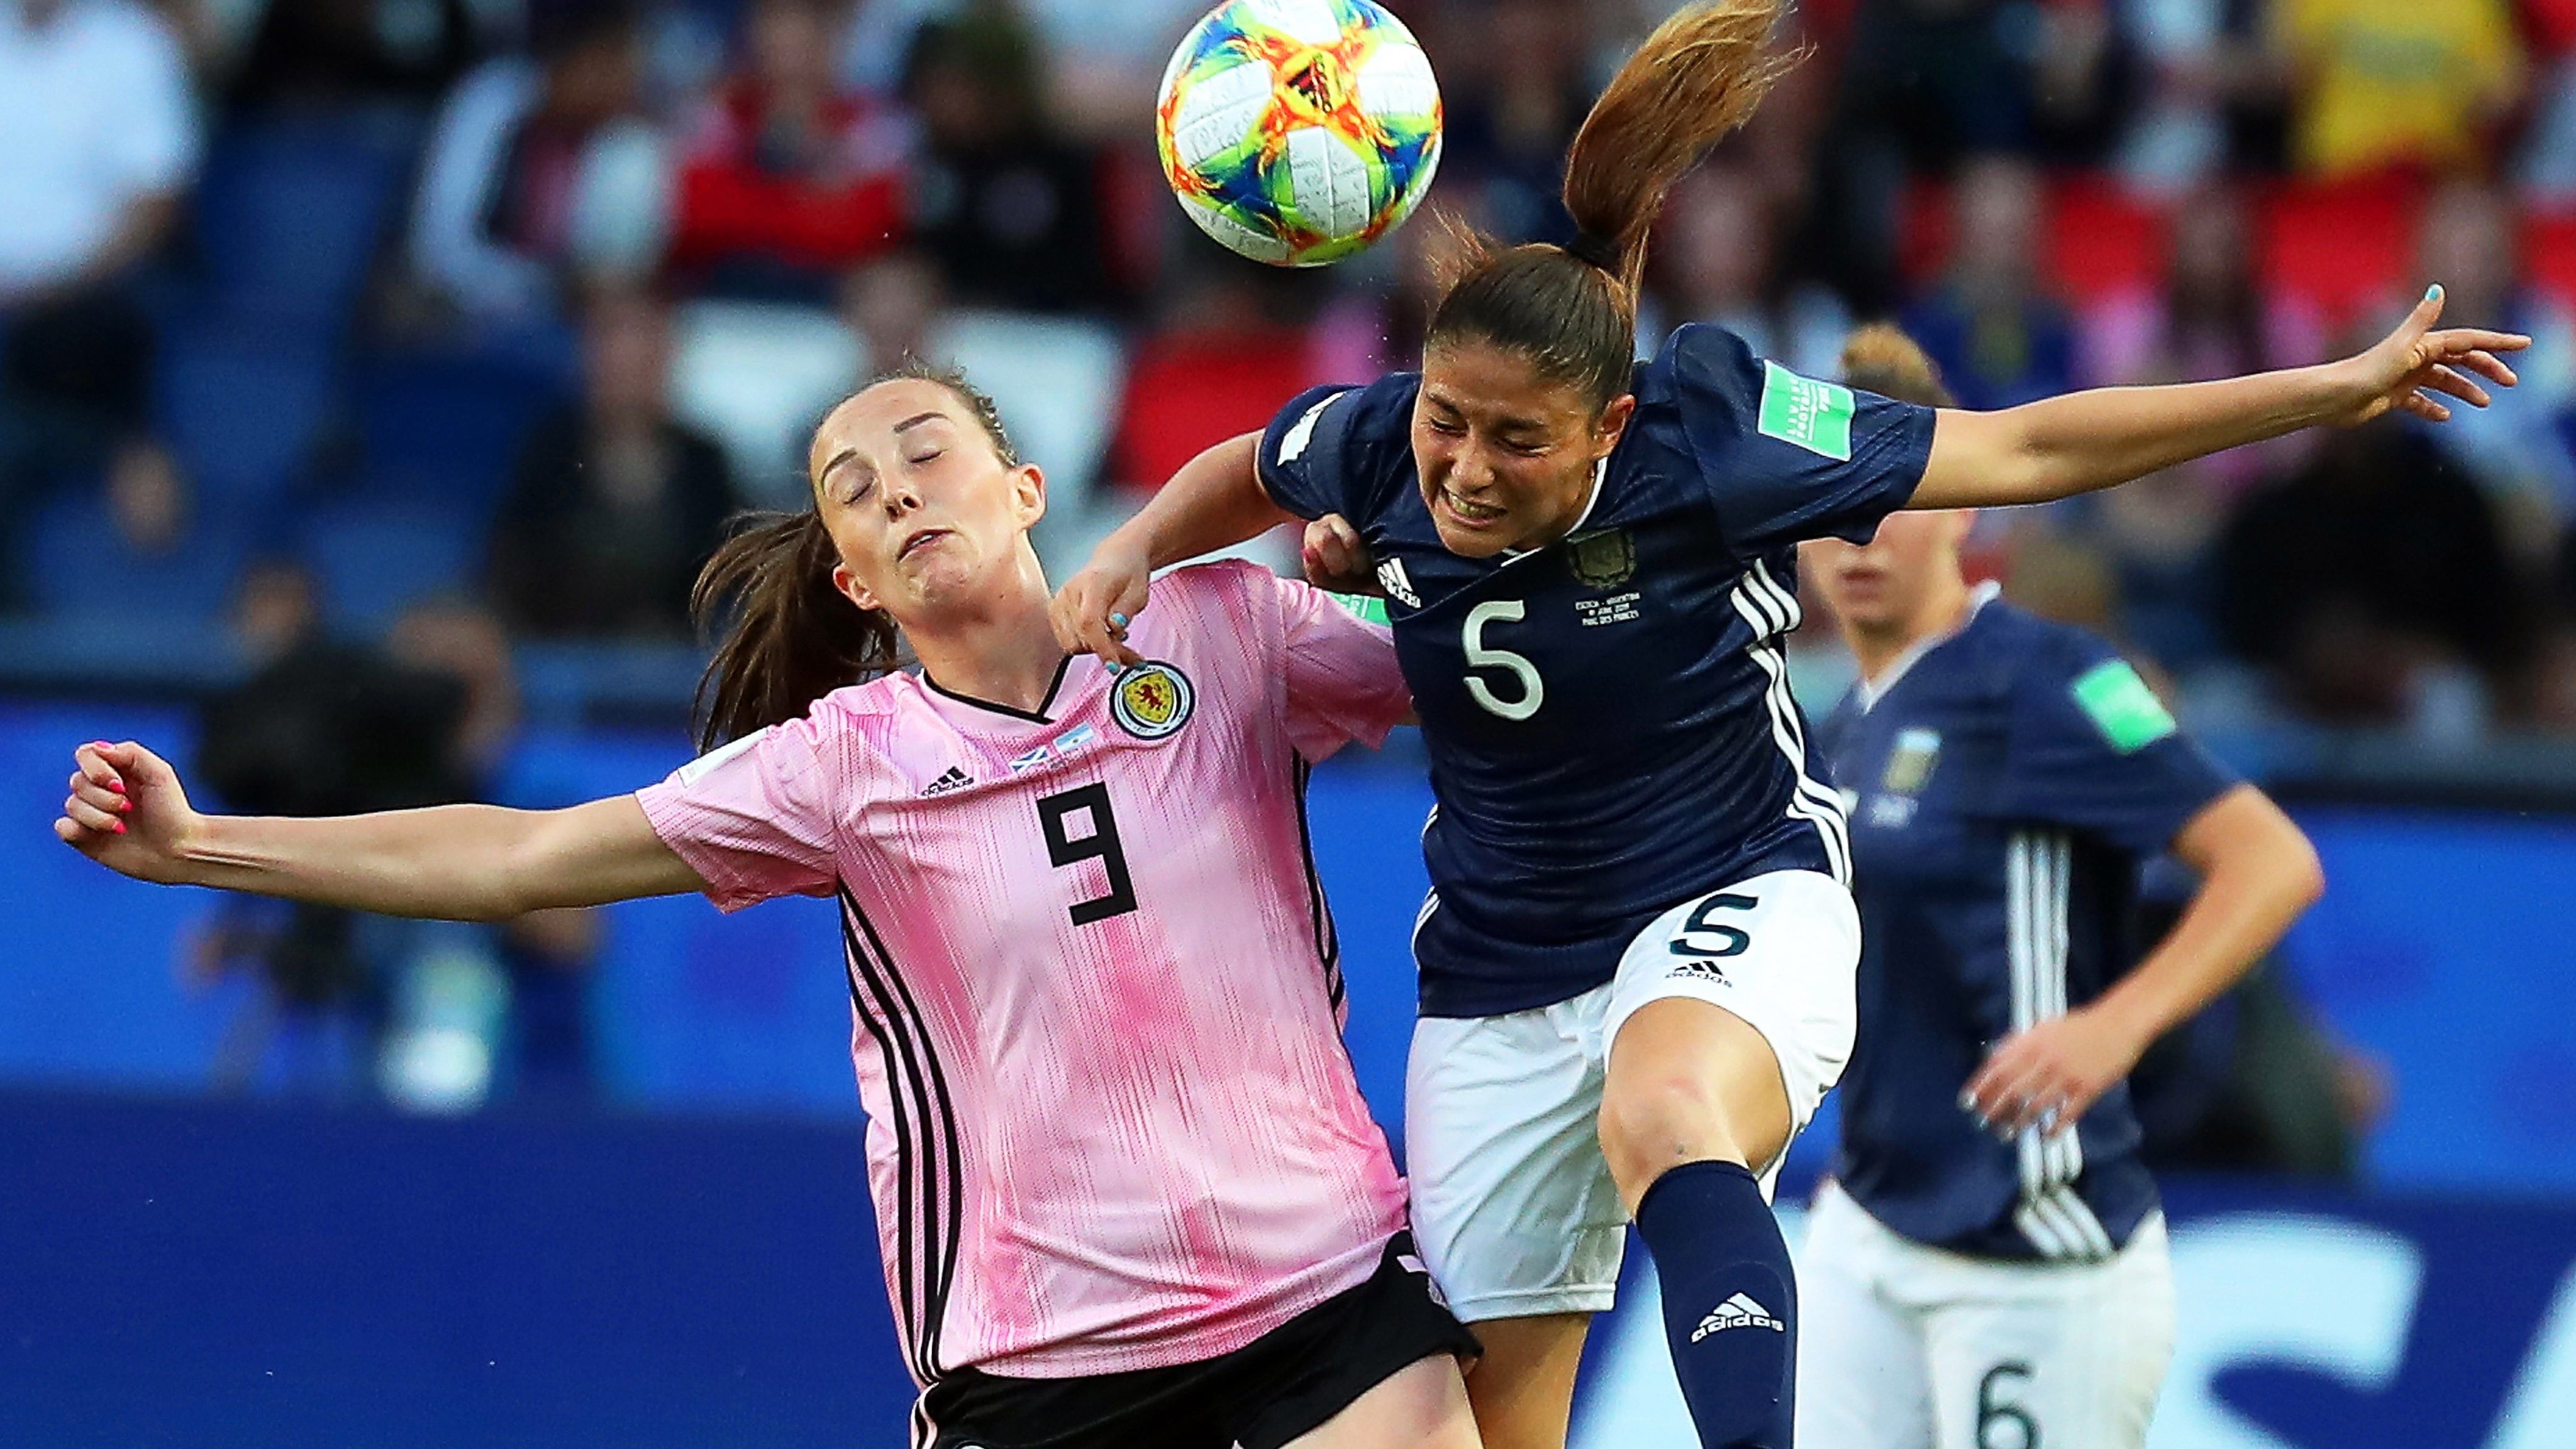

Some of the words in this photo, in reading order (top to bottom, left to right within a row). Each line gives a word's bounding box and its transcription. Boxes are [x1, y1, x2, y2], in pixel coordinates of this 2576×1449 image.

[1462, 600, 1543, 721] 5
[1036, 782, 1137, 927] 9
[1668, 893, 1759, 957] 5
[1690, 1313, 1784, 1343] adidas
[1977, 1359, 2041, 1449] 6
